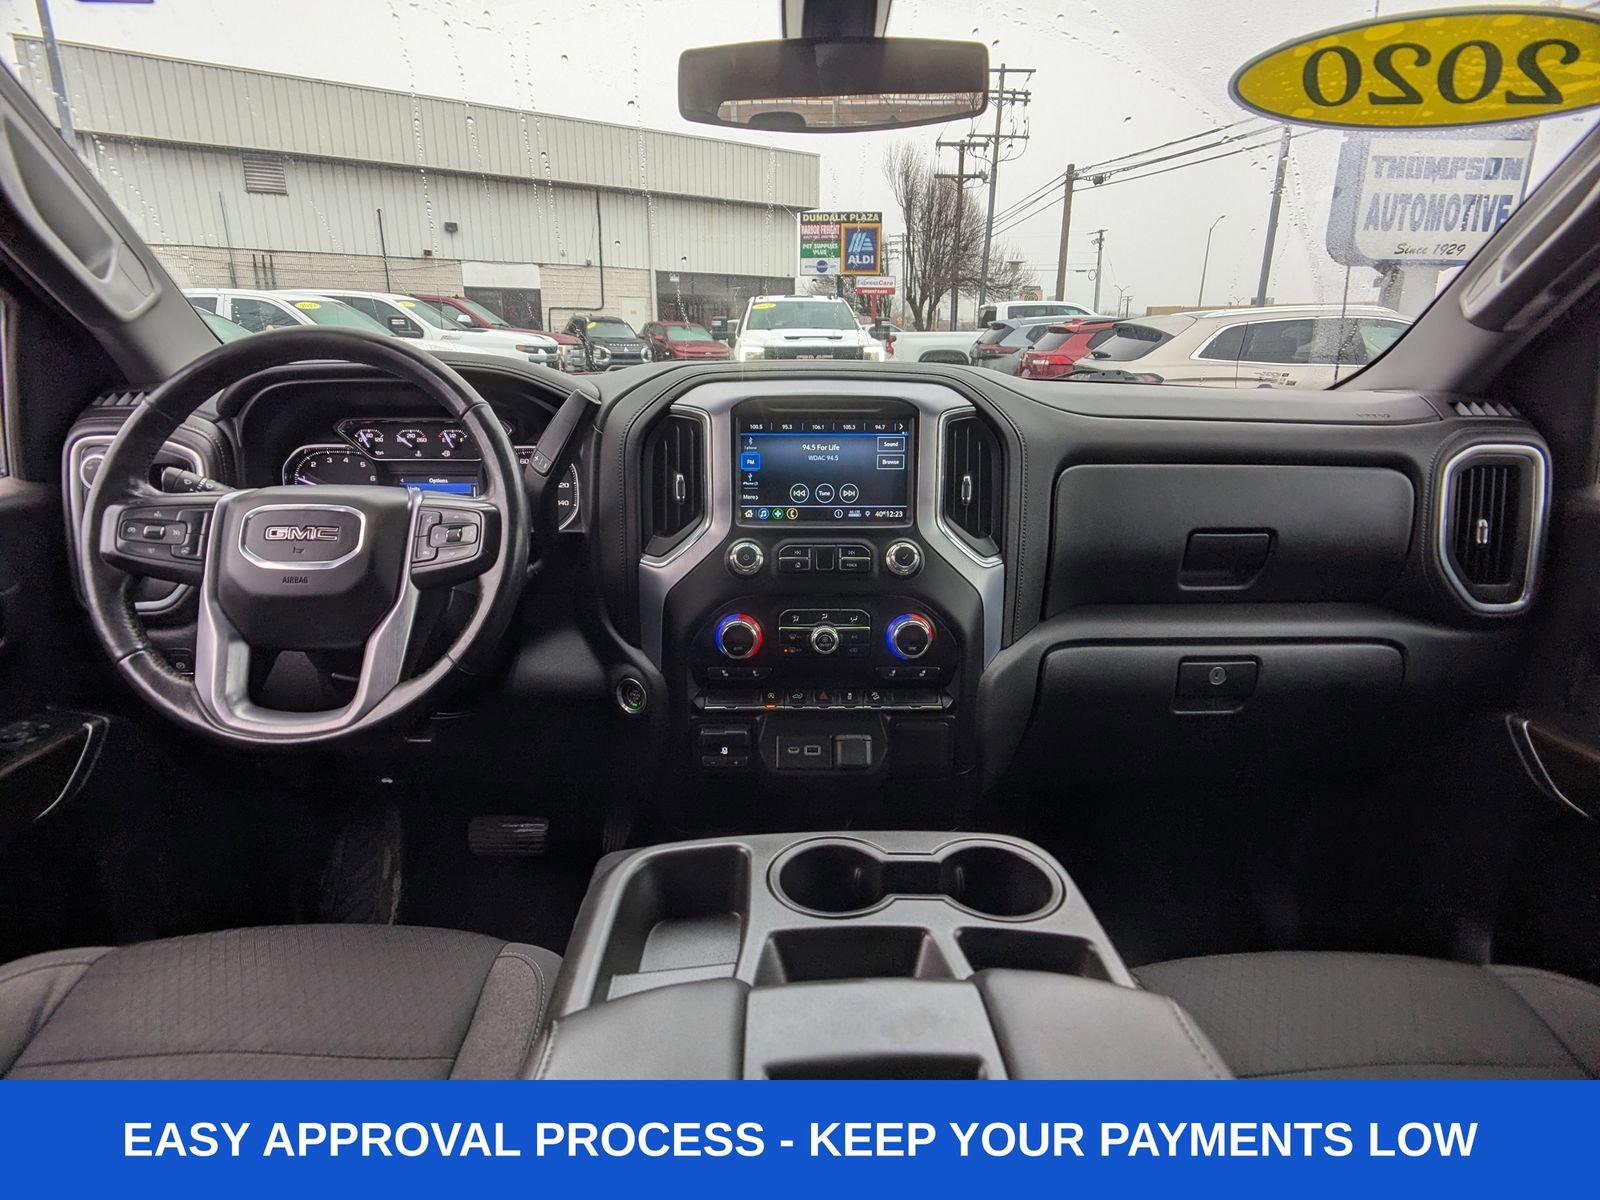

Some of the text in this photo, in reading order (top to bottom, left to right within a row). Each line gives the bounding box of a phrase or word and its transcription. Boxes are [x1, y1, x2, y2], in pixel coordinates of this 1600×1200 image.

[1371, 155, 1525, 182] THOMPSON
[802, 213, 880, 222] DUNDALK PLAZA
[1363, 193, 1514, 233] AUTOMOTIVE
[1393, 242, 1466, 256] Since 1929
[847, 255, 874, 264] ALDI
[264, 525, 339, 541] GMC
[281, 576, 310, 584] AIRBAG
